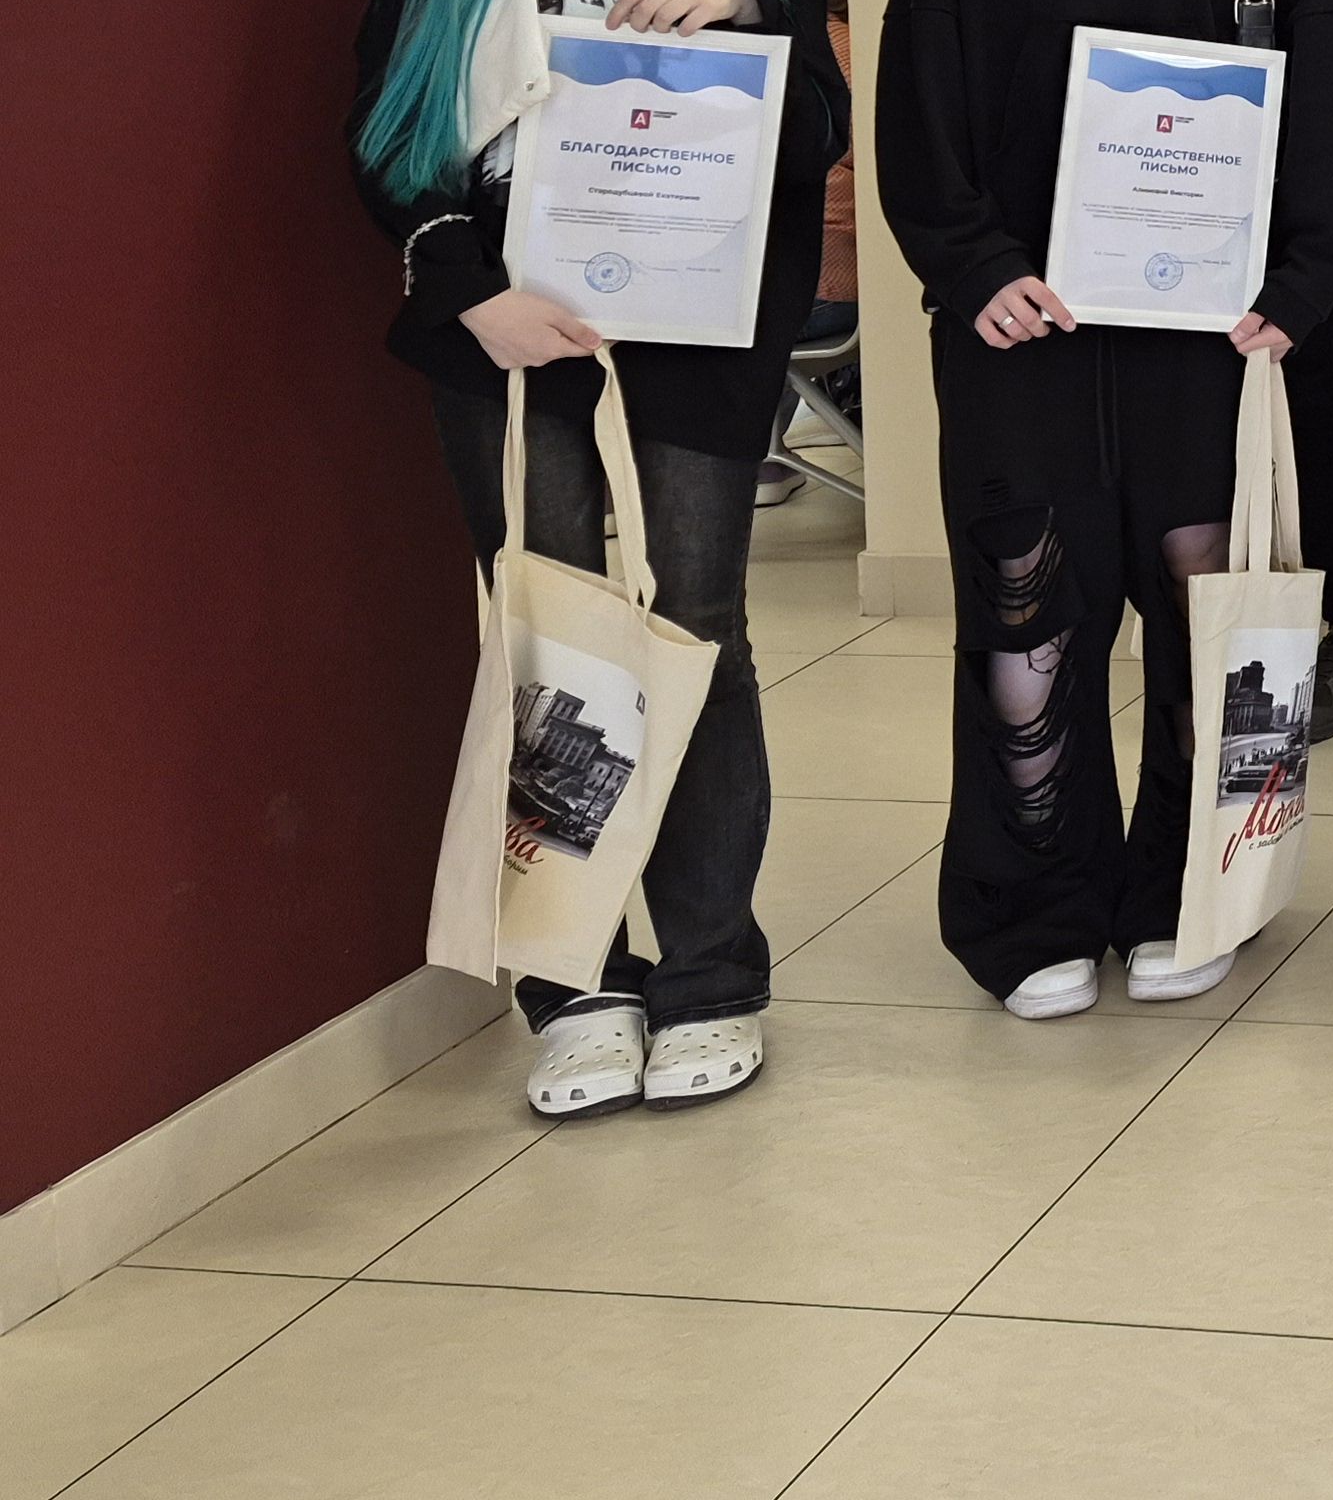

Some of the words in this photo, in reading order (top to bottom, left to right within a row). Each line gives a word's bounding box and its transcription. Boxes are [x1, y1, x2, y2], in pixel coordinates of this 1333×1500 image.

[560, 140, 735, 165] БЛАГОДАРСТВЕННОЕ
[1098, 142, 1241, 166] БЛАГОДАРСТВЕННОЕ
[611, 161, 682, 176] ПИСЬМО
[1140, 161, 1199, 176] ПИСЬМО
